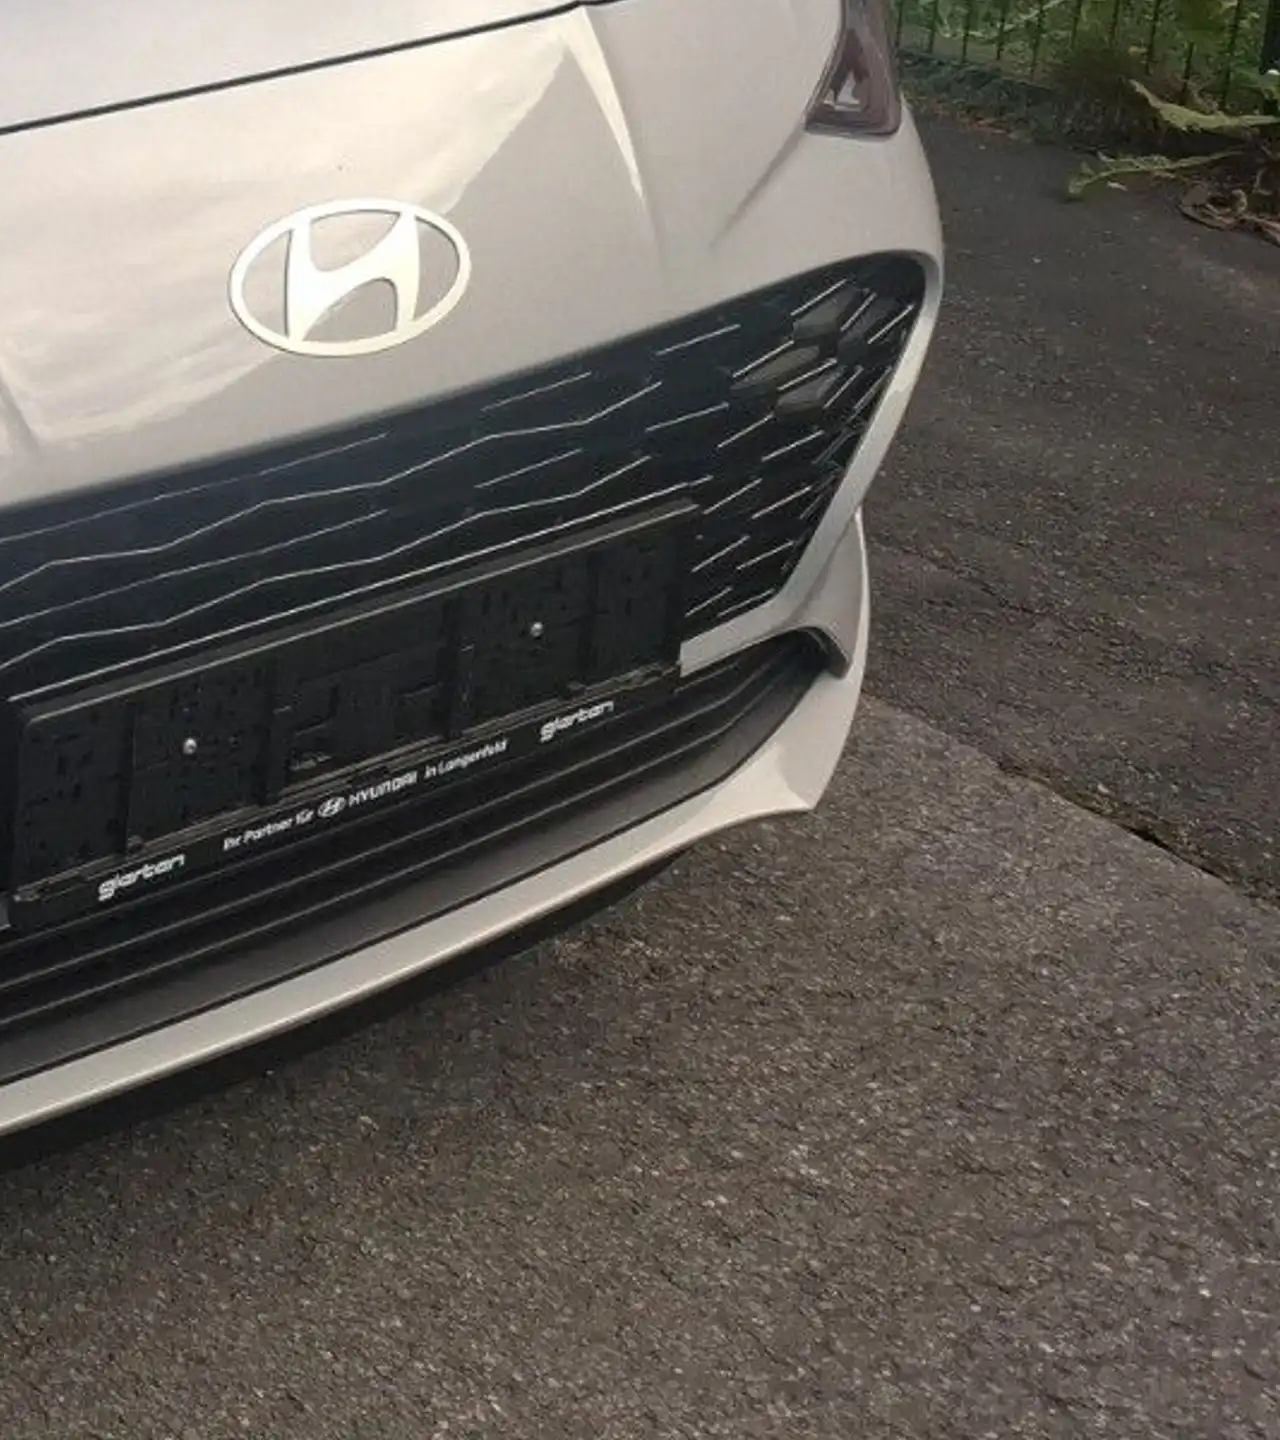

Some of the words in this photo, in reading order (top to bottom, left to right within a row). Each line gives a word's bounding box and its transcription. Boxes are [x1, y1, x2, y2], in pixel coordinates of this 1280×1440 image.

[223, 835, 243, 851] Ihr
[243, 818, 293, 844] Partner
[348, 771, 419, 807] HYUNDAI
[424, 764, 437, 780] in
[438, 738, 509, 775] Langenfeld
